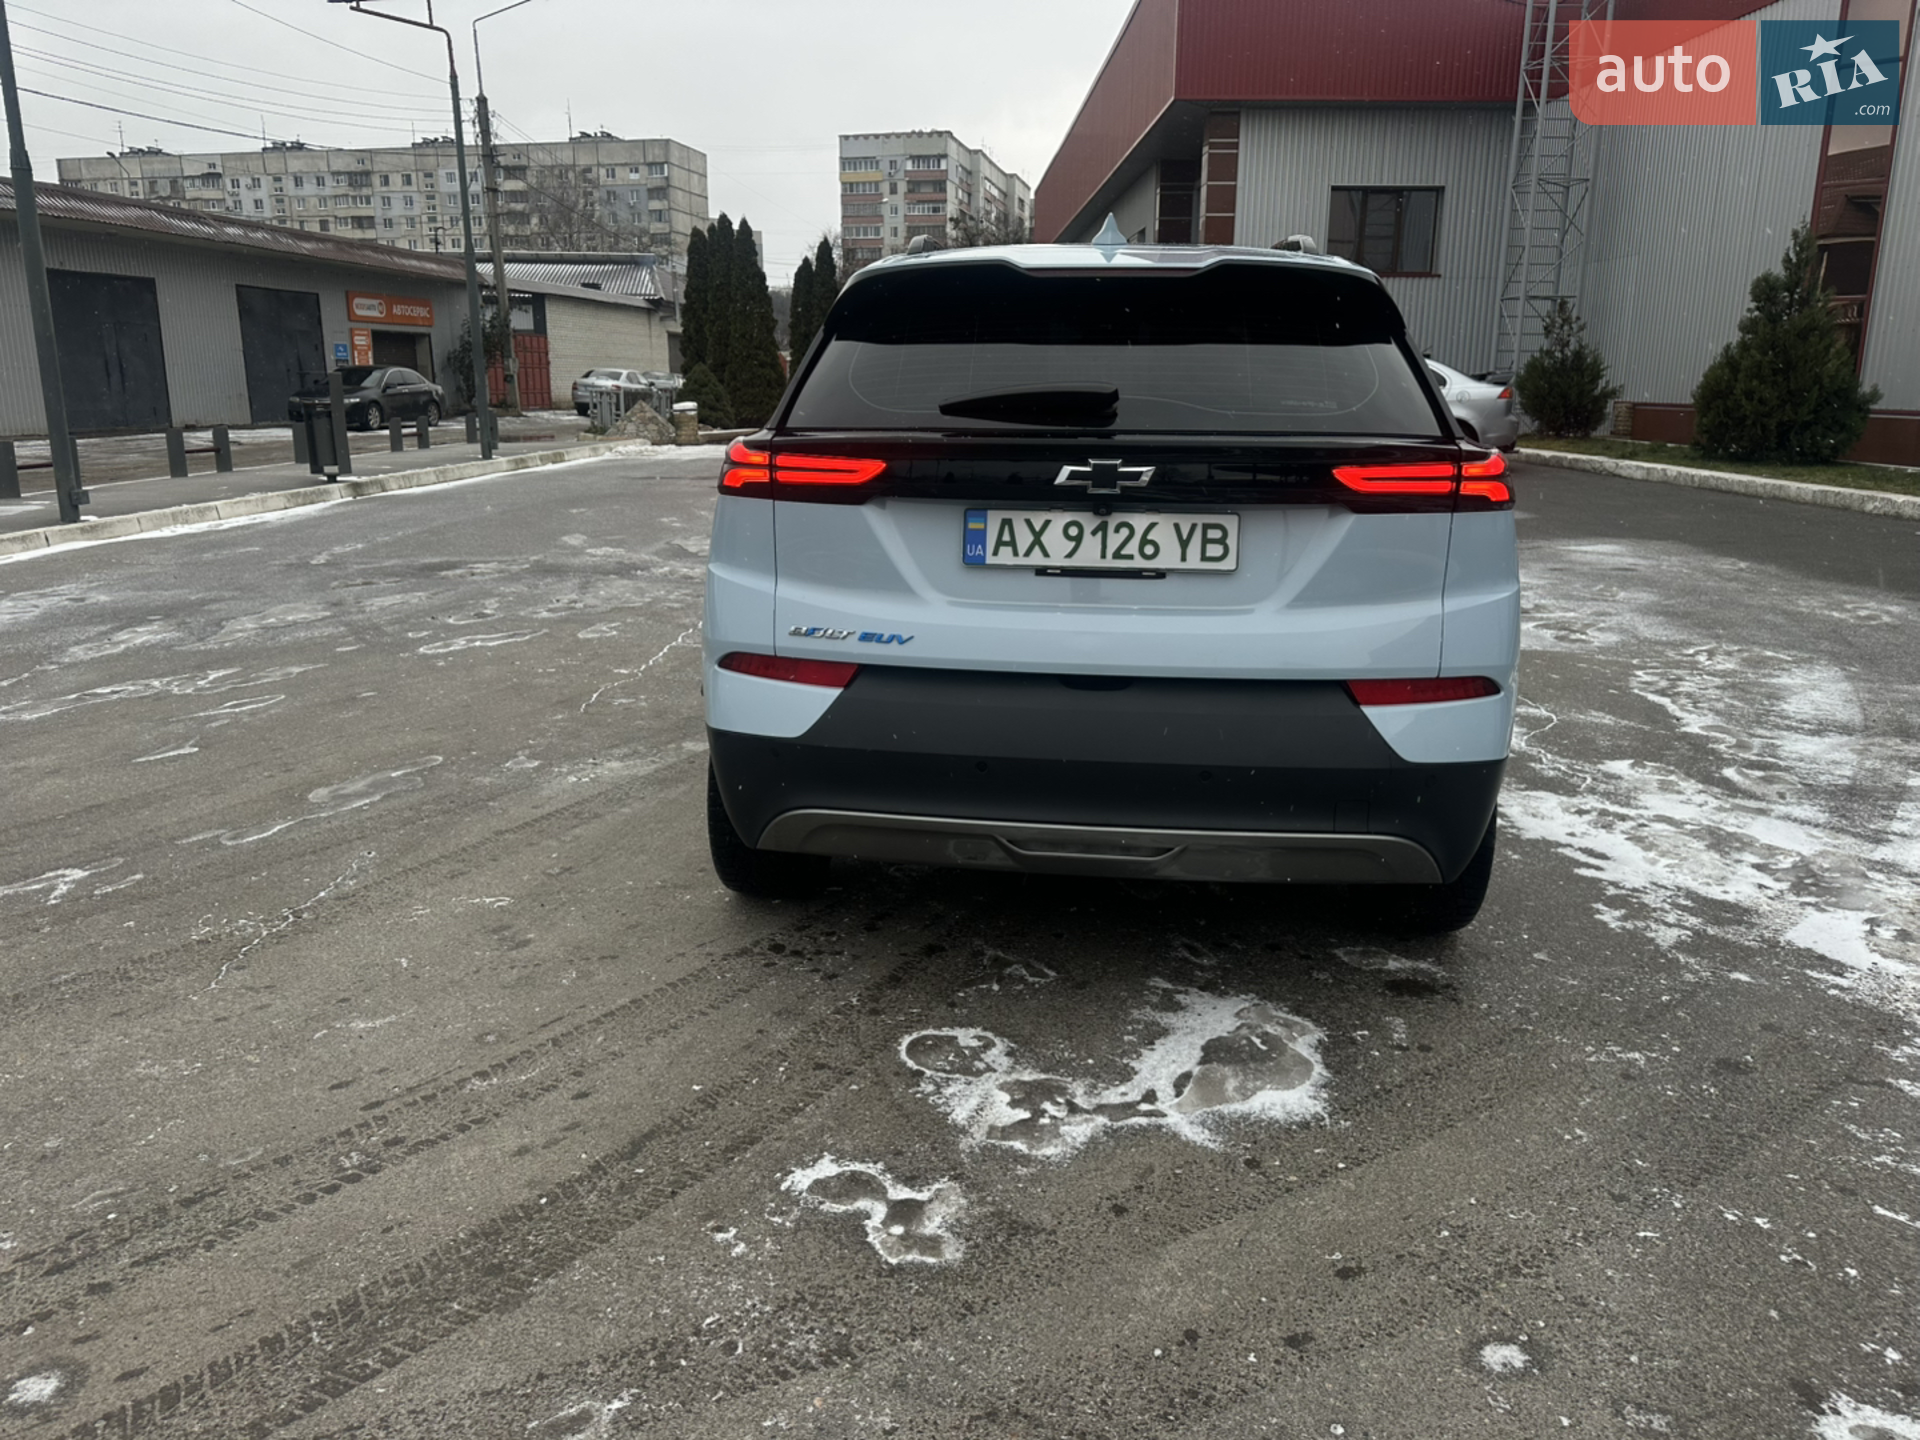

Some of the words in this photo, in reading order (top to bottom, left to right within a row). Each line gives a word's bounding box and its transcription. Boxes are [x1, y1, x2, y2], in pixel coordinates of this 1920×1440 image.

[392, 304, 430, 317] АВТОСЕРВІС
[991, 517, 1053, 558] AX
[1061, 519, 1161, 561] 9126
[1172, 522, 1231, 563] YB
[966, 544, 984, 557] UA
[788, 625, 856, 640] BOLT
[857, 631, 915, 645] EUV
